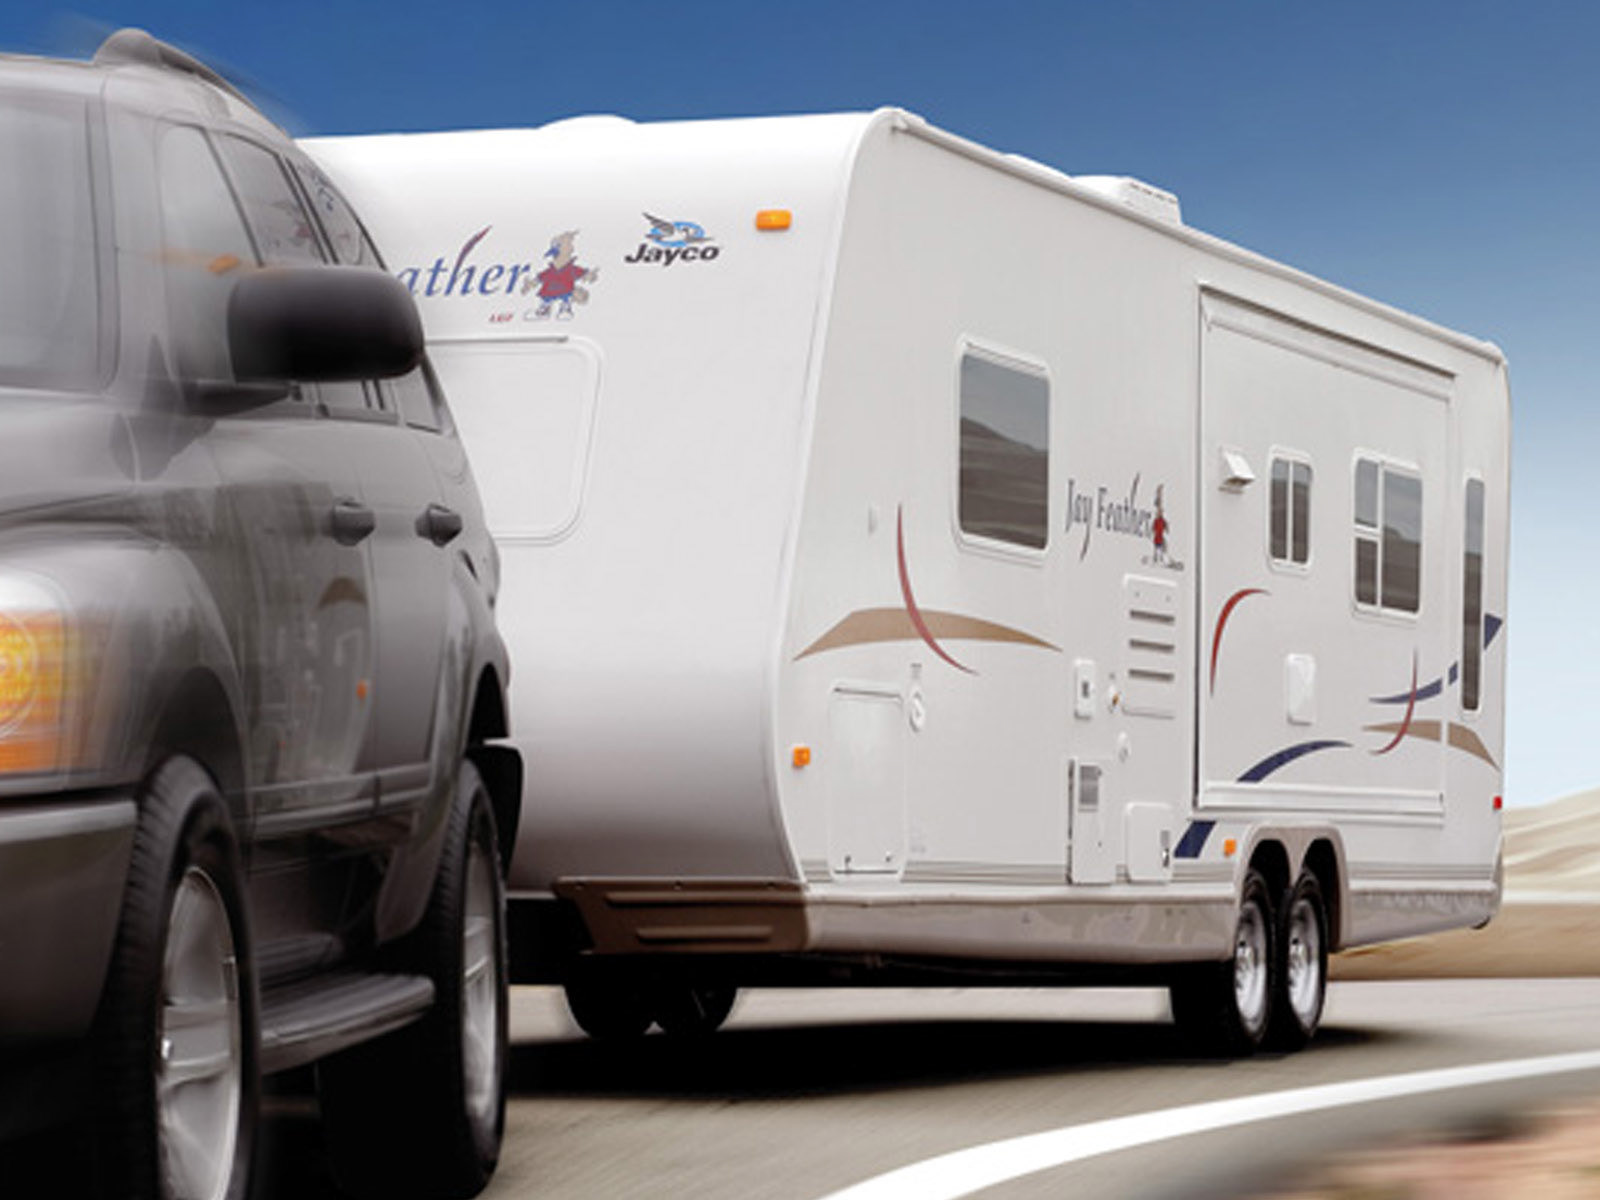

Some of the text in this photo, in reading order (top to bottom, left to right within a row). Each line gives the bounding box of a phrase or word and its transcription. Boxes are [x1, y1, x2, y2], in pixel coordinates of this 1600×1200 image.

[625, 244, 720, 267] Jayco
[1065, 472, 1151, 562] Jay Feather
